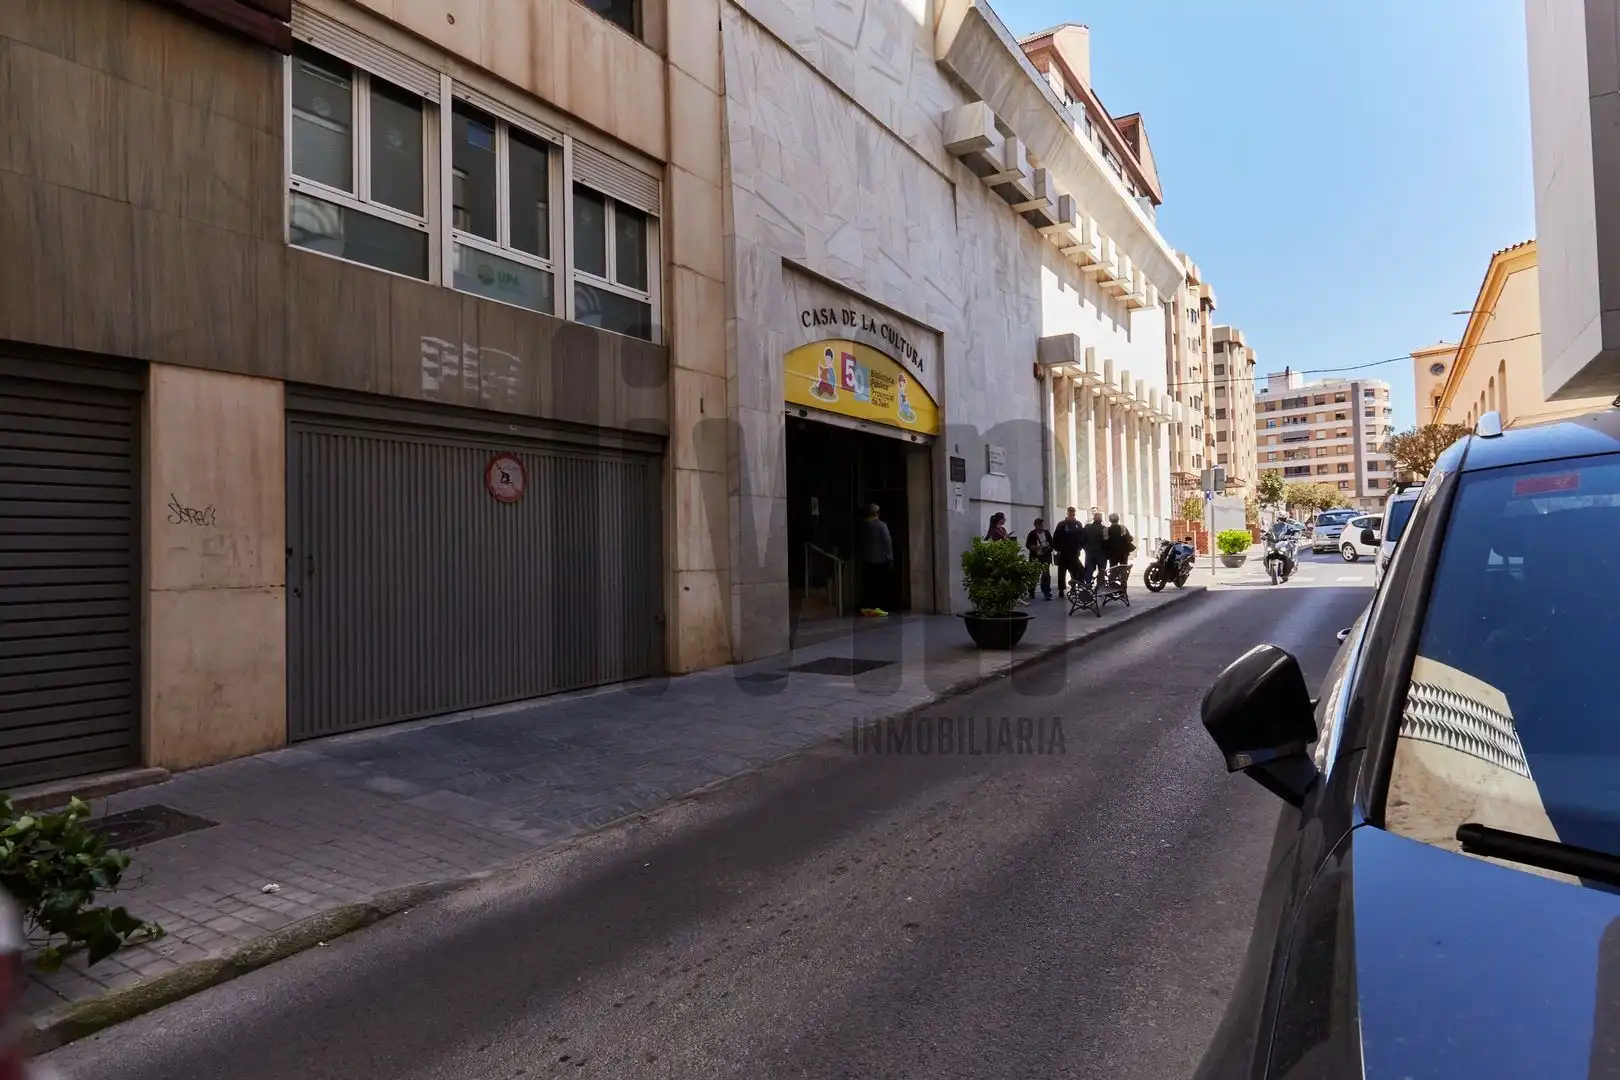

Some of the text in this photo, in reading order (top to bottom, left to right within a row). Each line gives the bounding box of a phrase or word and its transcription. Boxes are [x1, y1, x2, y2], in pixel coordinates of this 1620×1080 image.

[801, 308, 924, 373] CASA DE LA CULTURA
